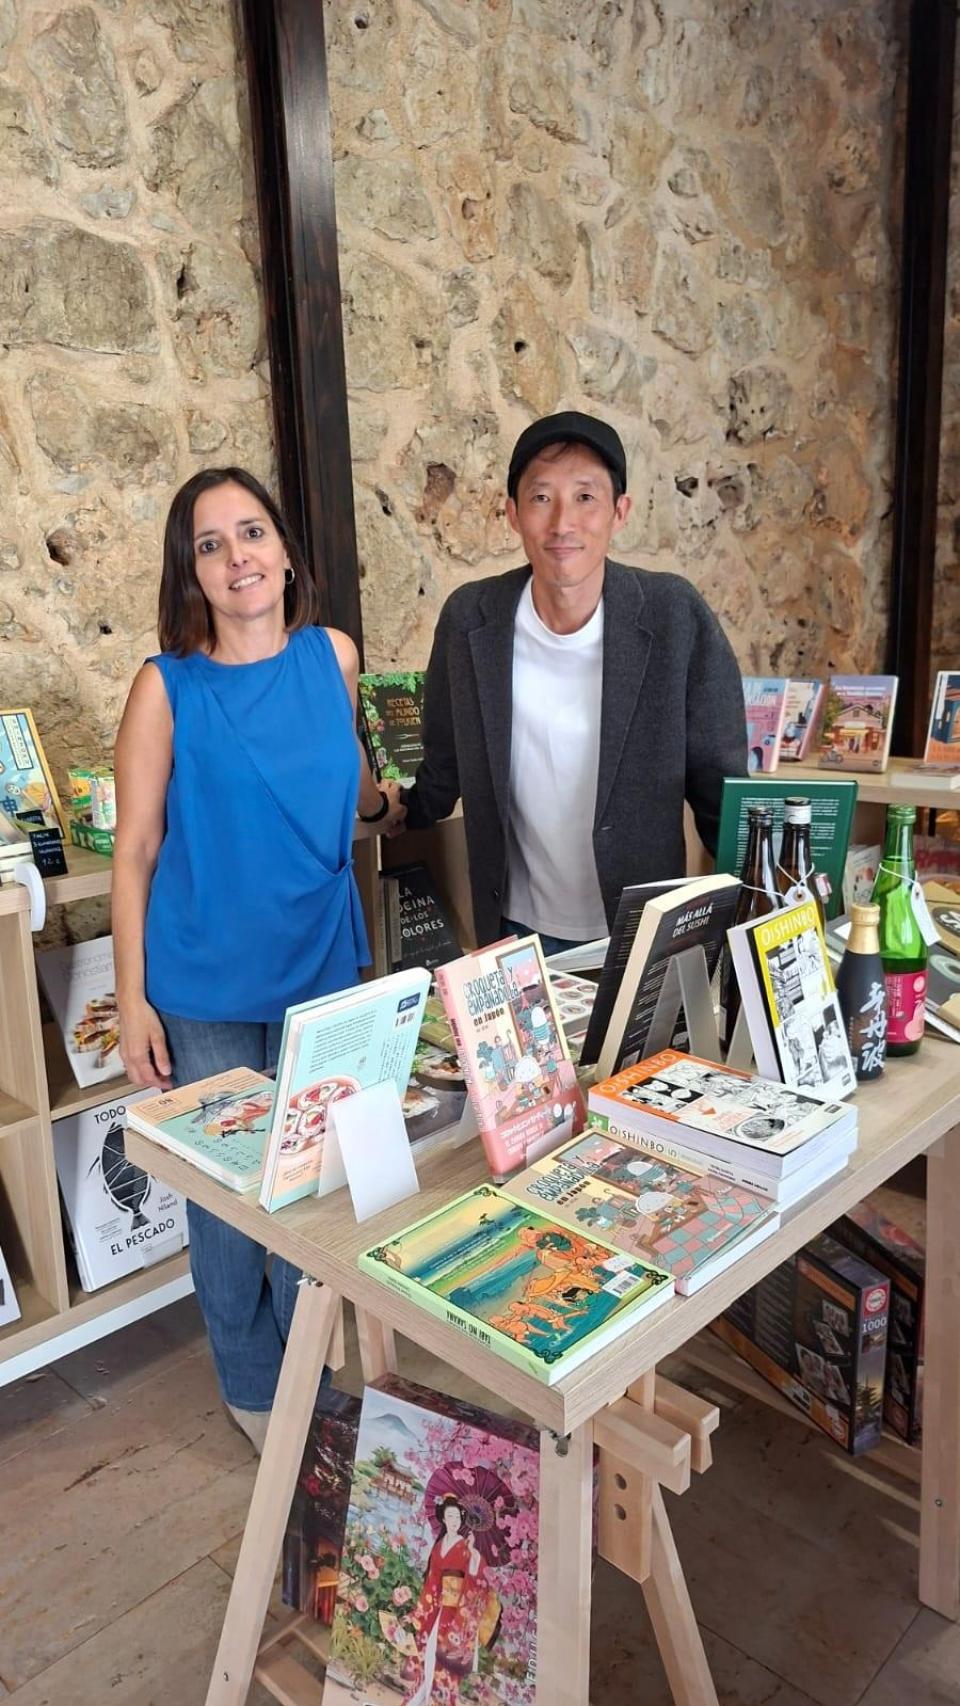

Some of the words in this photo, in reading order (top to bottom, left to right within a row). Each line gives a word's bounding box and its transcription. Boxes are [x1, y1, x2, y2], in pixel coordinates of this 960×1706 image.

[400, 918, 445, 939] OLORES
[761, 905, 815, 946] OISHINBO
[599, 1053, 677, 1093] OISHINBO
[94, 1105, 127, 1124] TODO
[609, 1124, 665, 1154] OISHINBO
[110, 1244, 124, 1256] EL
[126, 1218, 175, 1247] PESCADO
[862, 1316, 888, 1333] 1000
